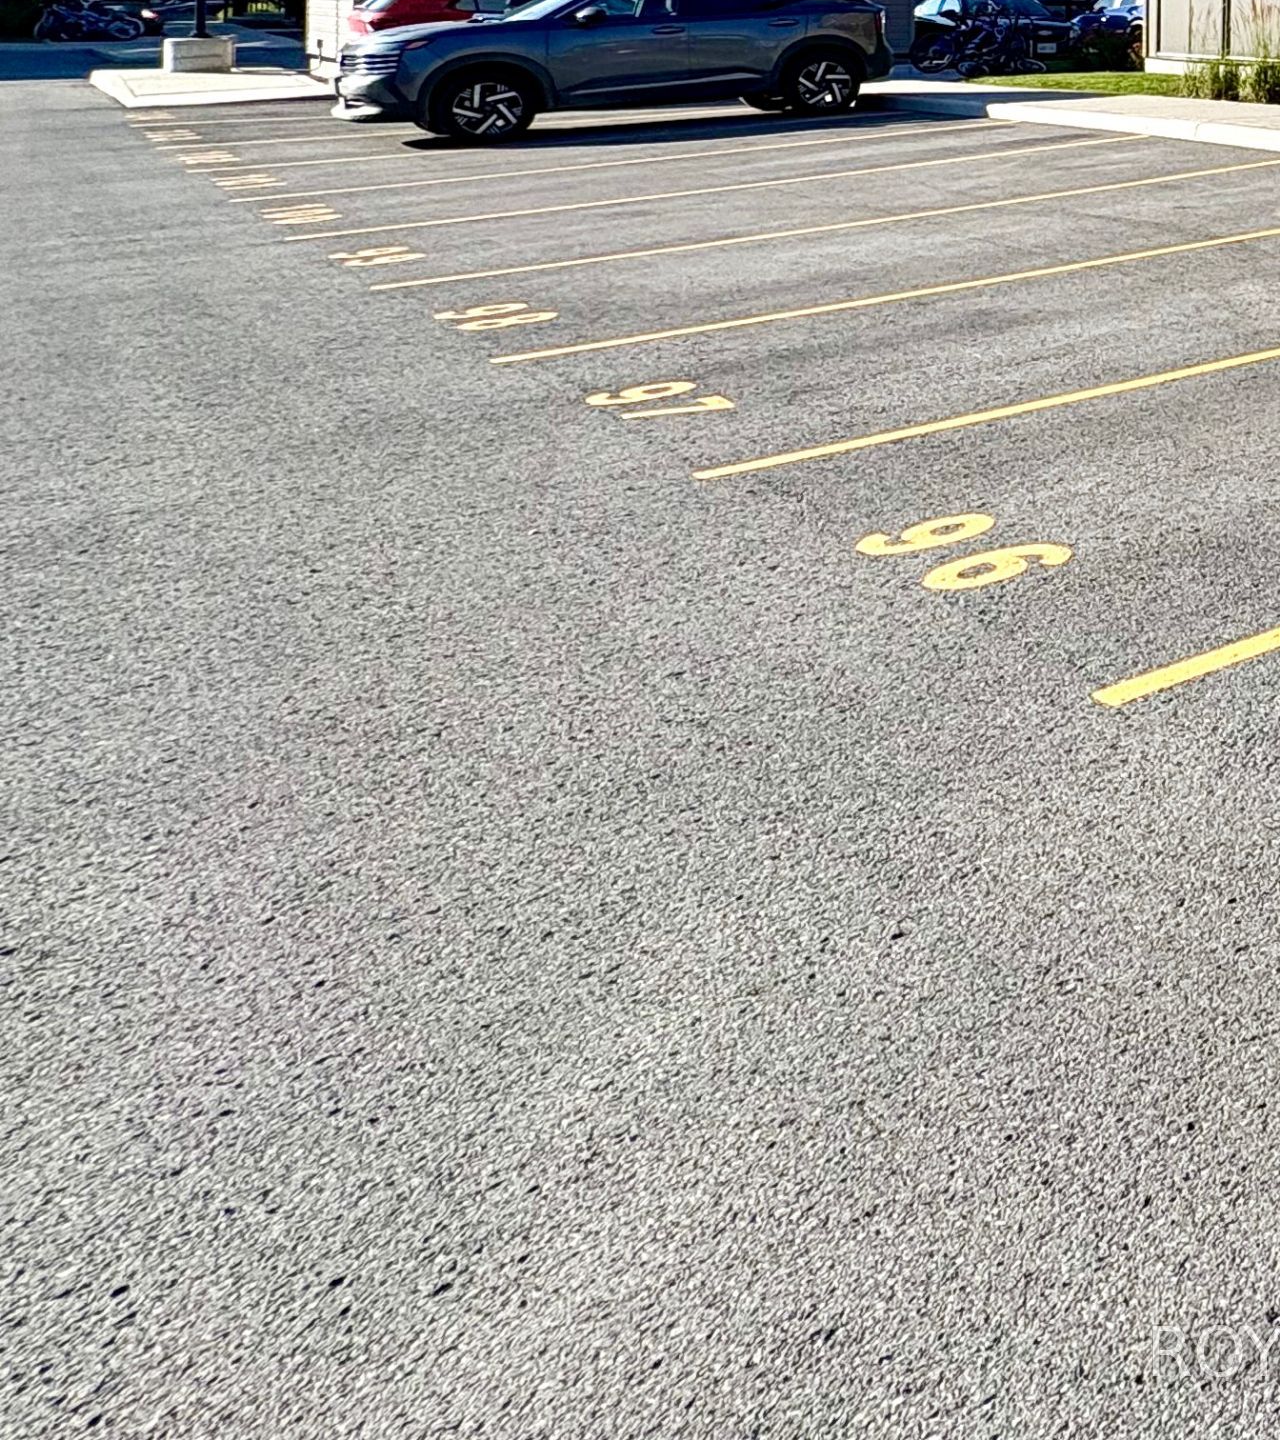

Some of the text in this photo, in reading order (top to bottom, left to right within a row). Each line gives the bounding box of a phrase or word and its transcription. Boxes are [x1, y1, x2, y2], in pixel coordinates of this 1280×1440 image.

[328, 246, 427, 267] 99
[433, 303, 558, 331] 98
[585, 381, 735, 420] 97
[855, 513, 1073, 591] 96
